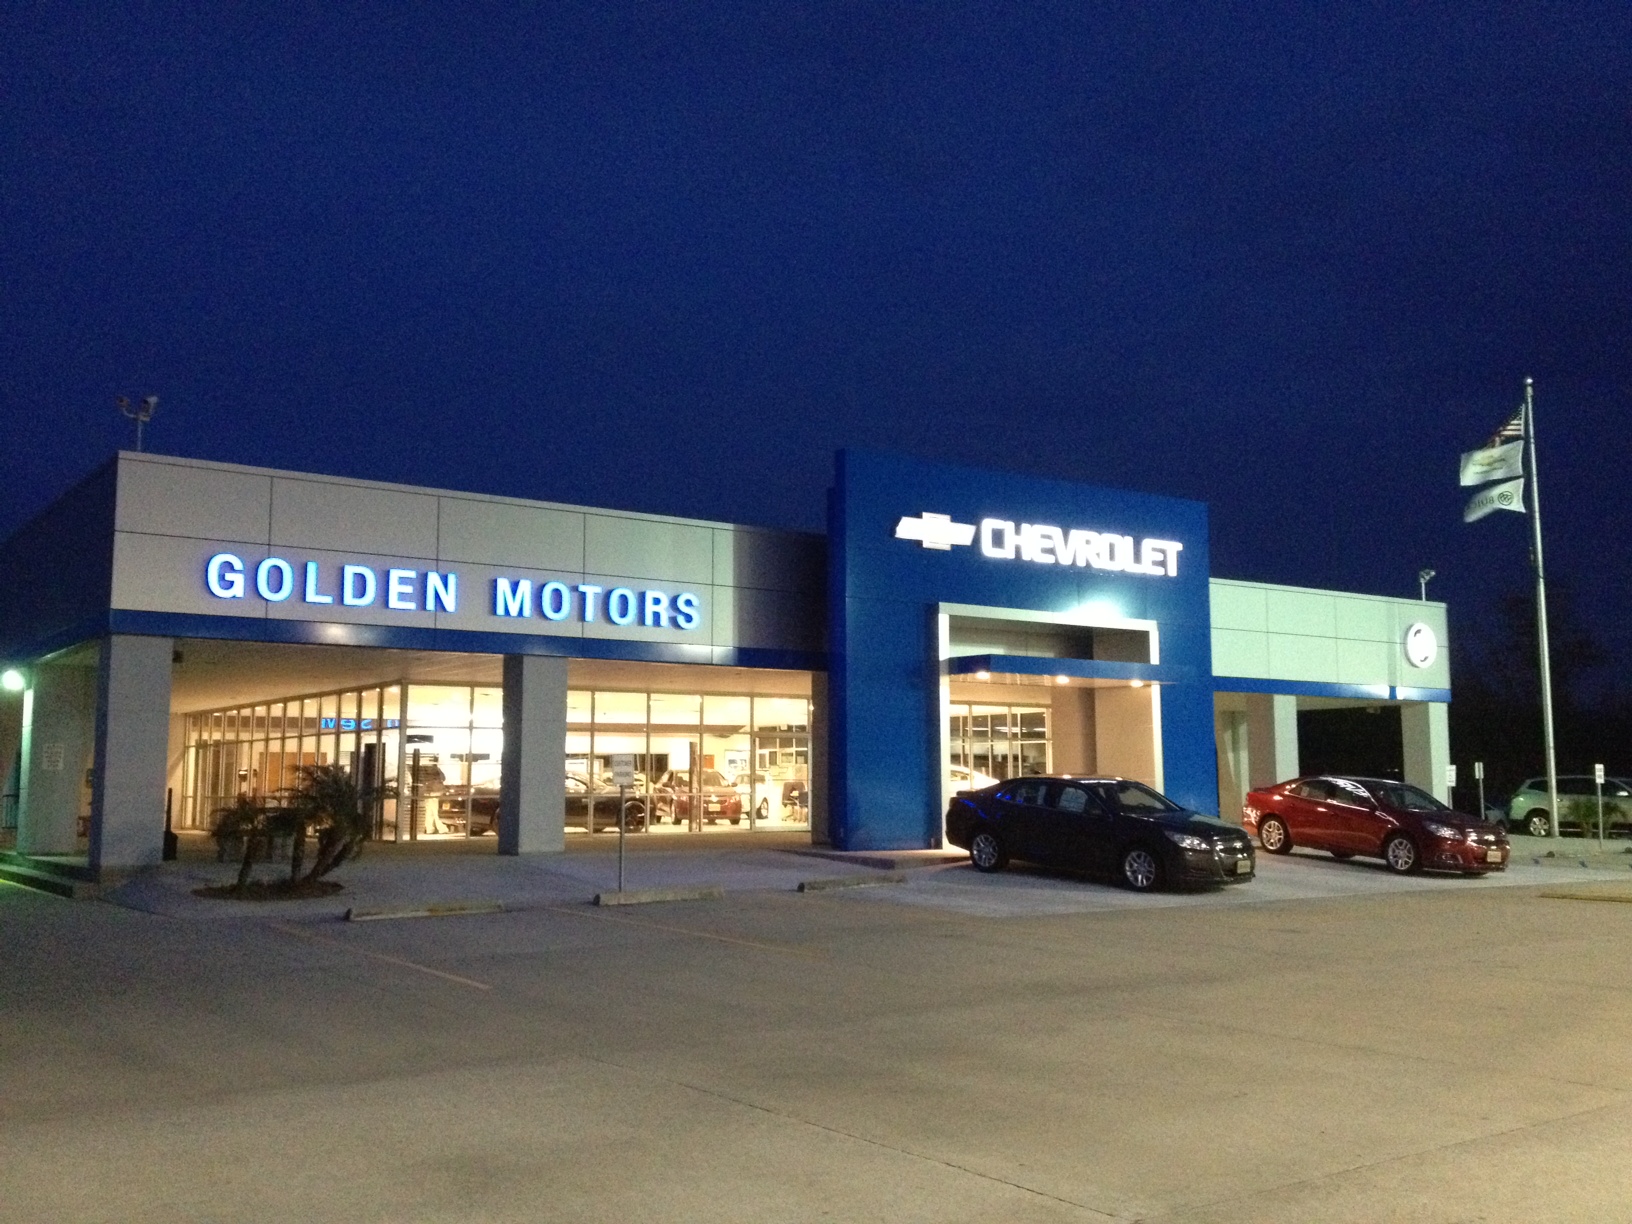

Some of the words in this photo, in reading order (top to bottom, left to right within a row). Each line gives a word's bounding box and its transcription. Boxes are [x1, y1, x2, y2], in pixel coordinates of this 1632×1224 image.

[981, 518, 1183, 577] CHEVROLET
[206, 553, 458, 613] GOLDEN
[494, 577, 701, 630] MOTORS
